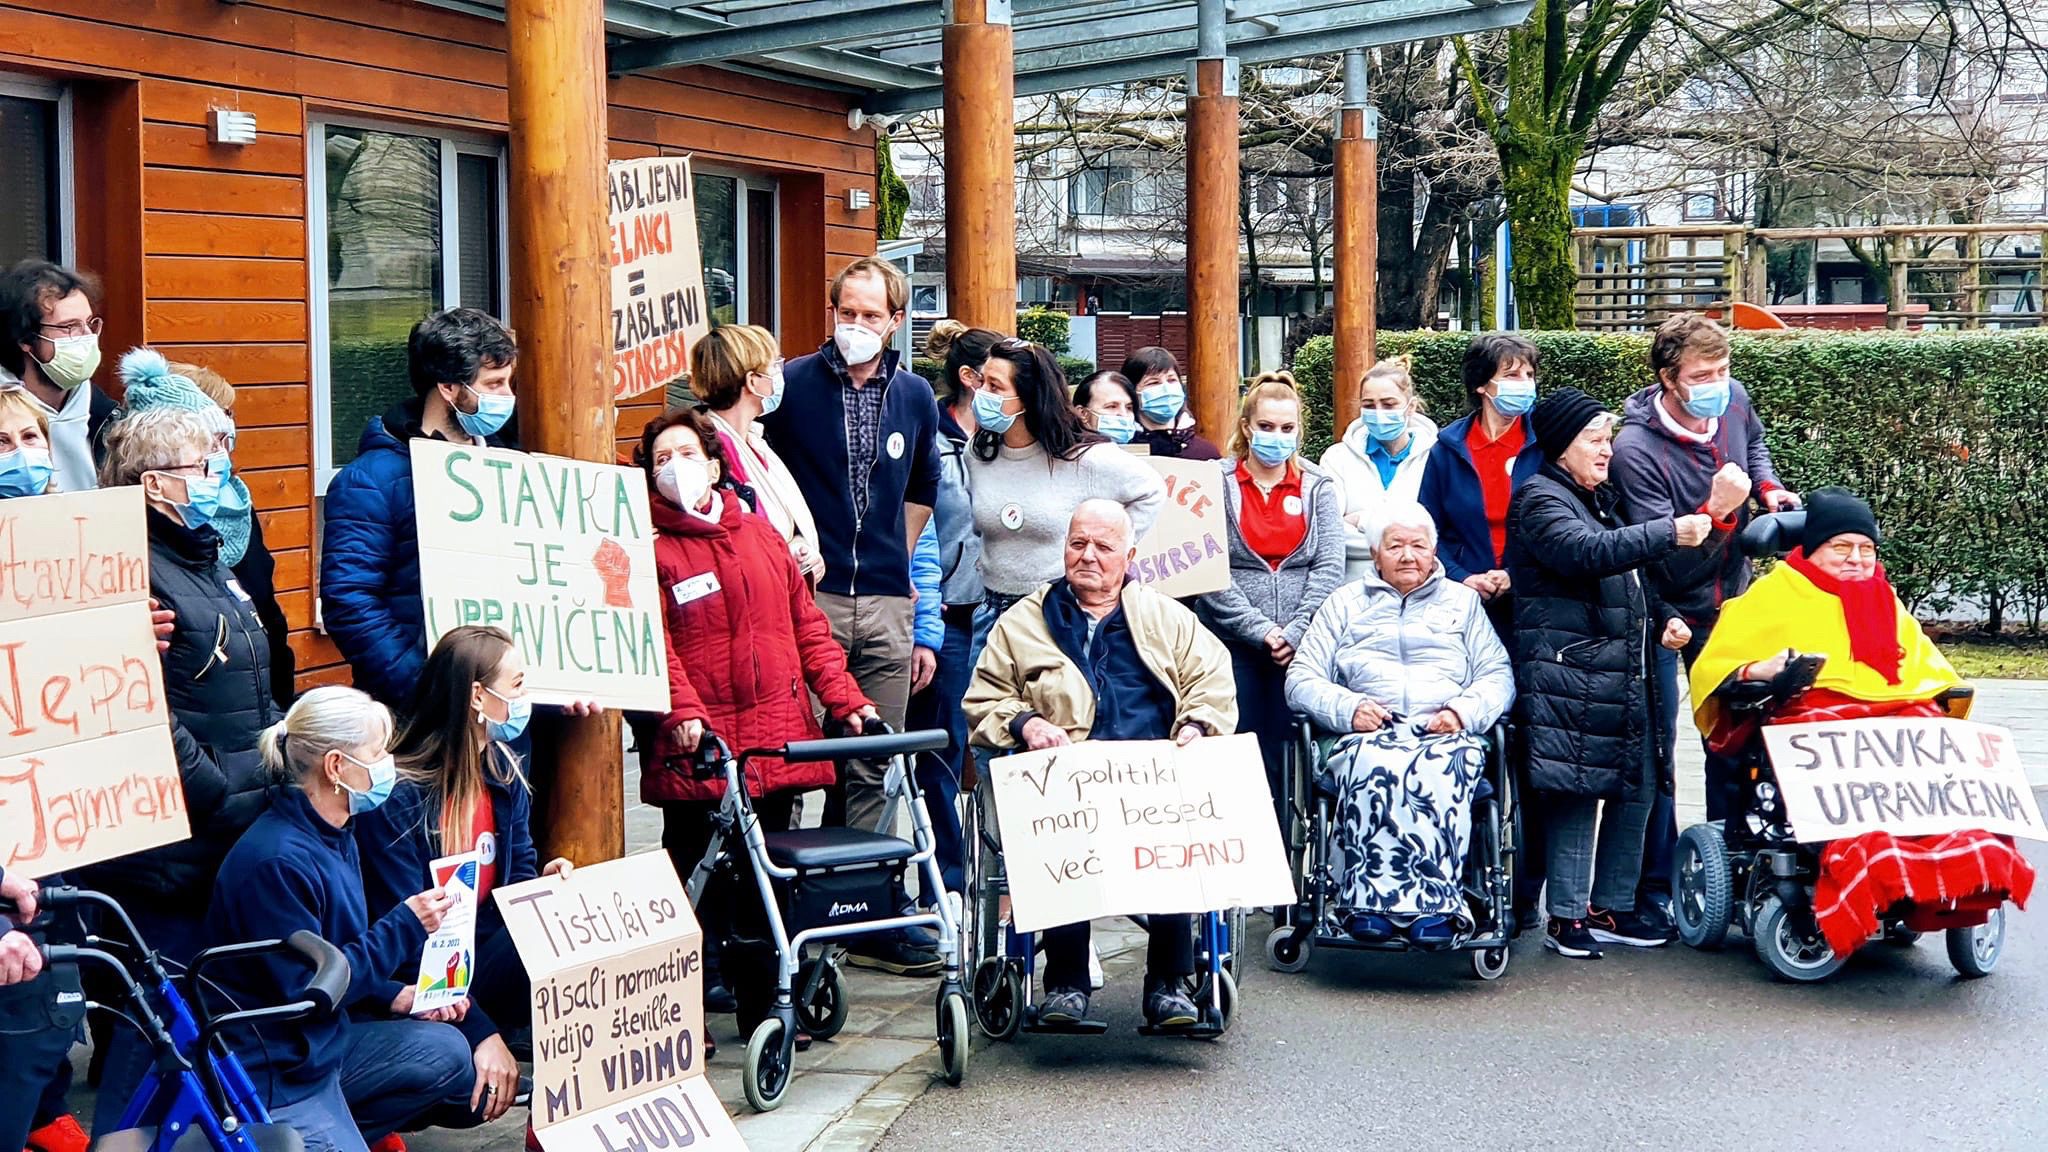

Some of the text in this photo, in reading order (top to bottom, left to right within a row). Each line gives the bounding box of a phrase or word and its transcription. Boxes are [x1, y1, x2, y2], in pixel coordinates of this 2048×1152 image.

[444, 450, 640, 539] STAVKA
[514, 541, 568, 587] JE
[1788, 726, 1967, 770] STAVKA
[1022, 755, 1177, 802] V politiki
[1813, 773, 2033, 827] UPRAVIČENA
[1032, 791, 1224, 836] manj besed
[1134, 838, 1246, 871] DEJANJ
[613, 891, 649, 939] ki
[648, 898, 676, 924] so
[839, 900, 869, 915] DMA
[615, 947, 701, 1001] normative
[539, 992, 682, 1064] vidijo številke
[544, 1028, 693, 1124] MI VIDIMO
[593, 1083, 711, 1152] LJUDI
